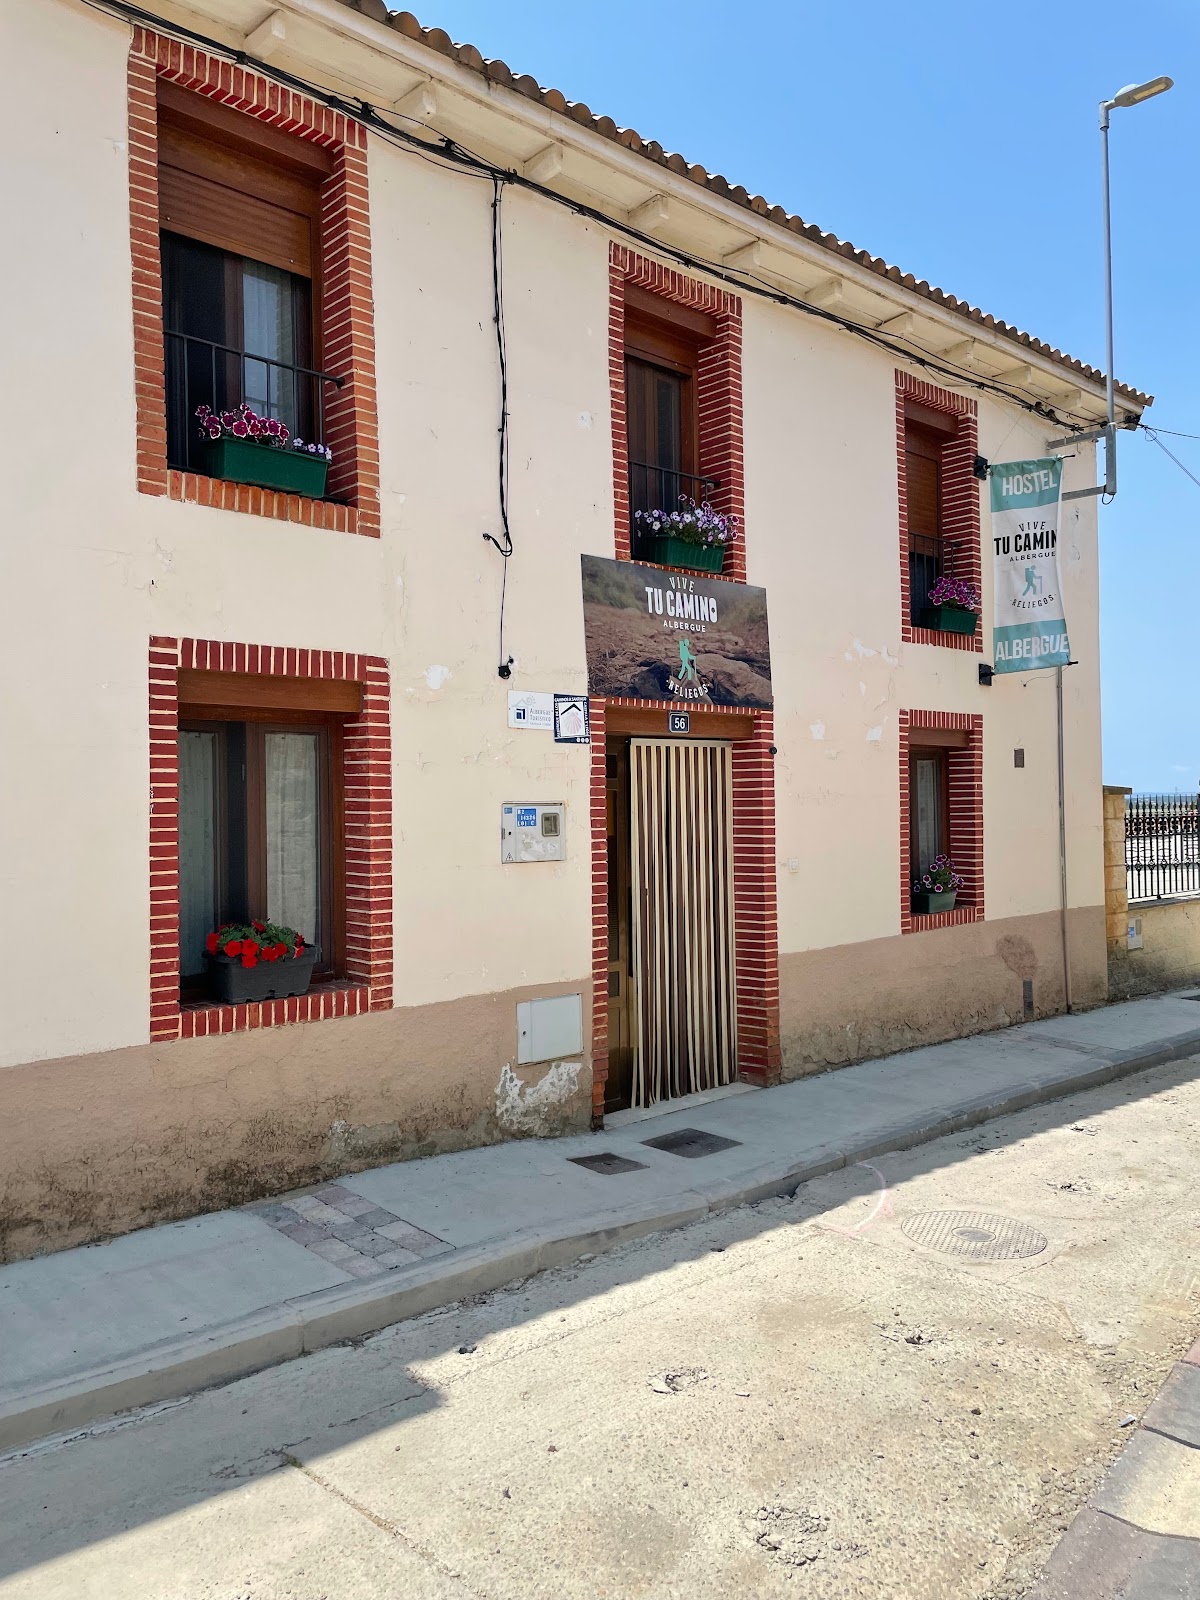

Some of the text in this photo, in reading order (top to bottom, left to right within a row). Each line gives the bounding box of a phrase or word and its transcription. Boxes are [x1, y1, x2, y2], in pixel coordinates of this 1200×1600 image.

[1002, 469, 1057, 496] HOSTEL
[1018, 521, 1046, 532] VIVE
[993, 529, 1057, 556] TU CAMIN
[1009, 551, 1056, 562] ALBERGUE
[669, 576, 695, 593] VIVE
[645, 586, 718, 623] TU CAMINO
[663, 620, 706, 633] ALBERGUE
[996, 633, 1069, 661] ALBERGUE
[674, 717, 686, 729] 56
